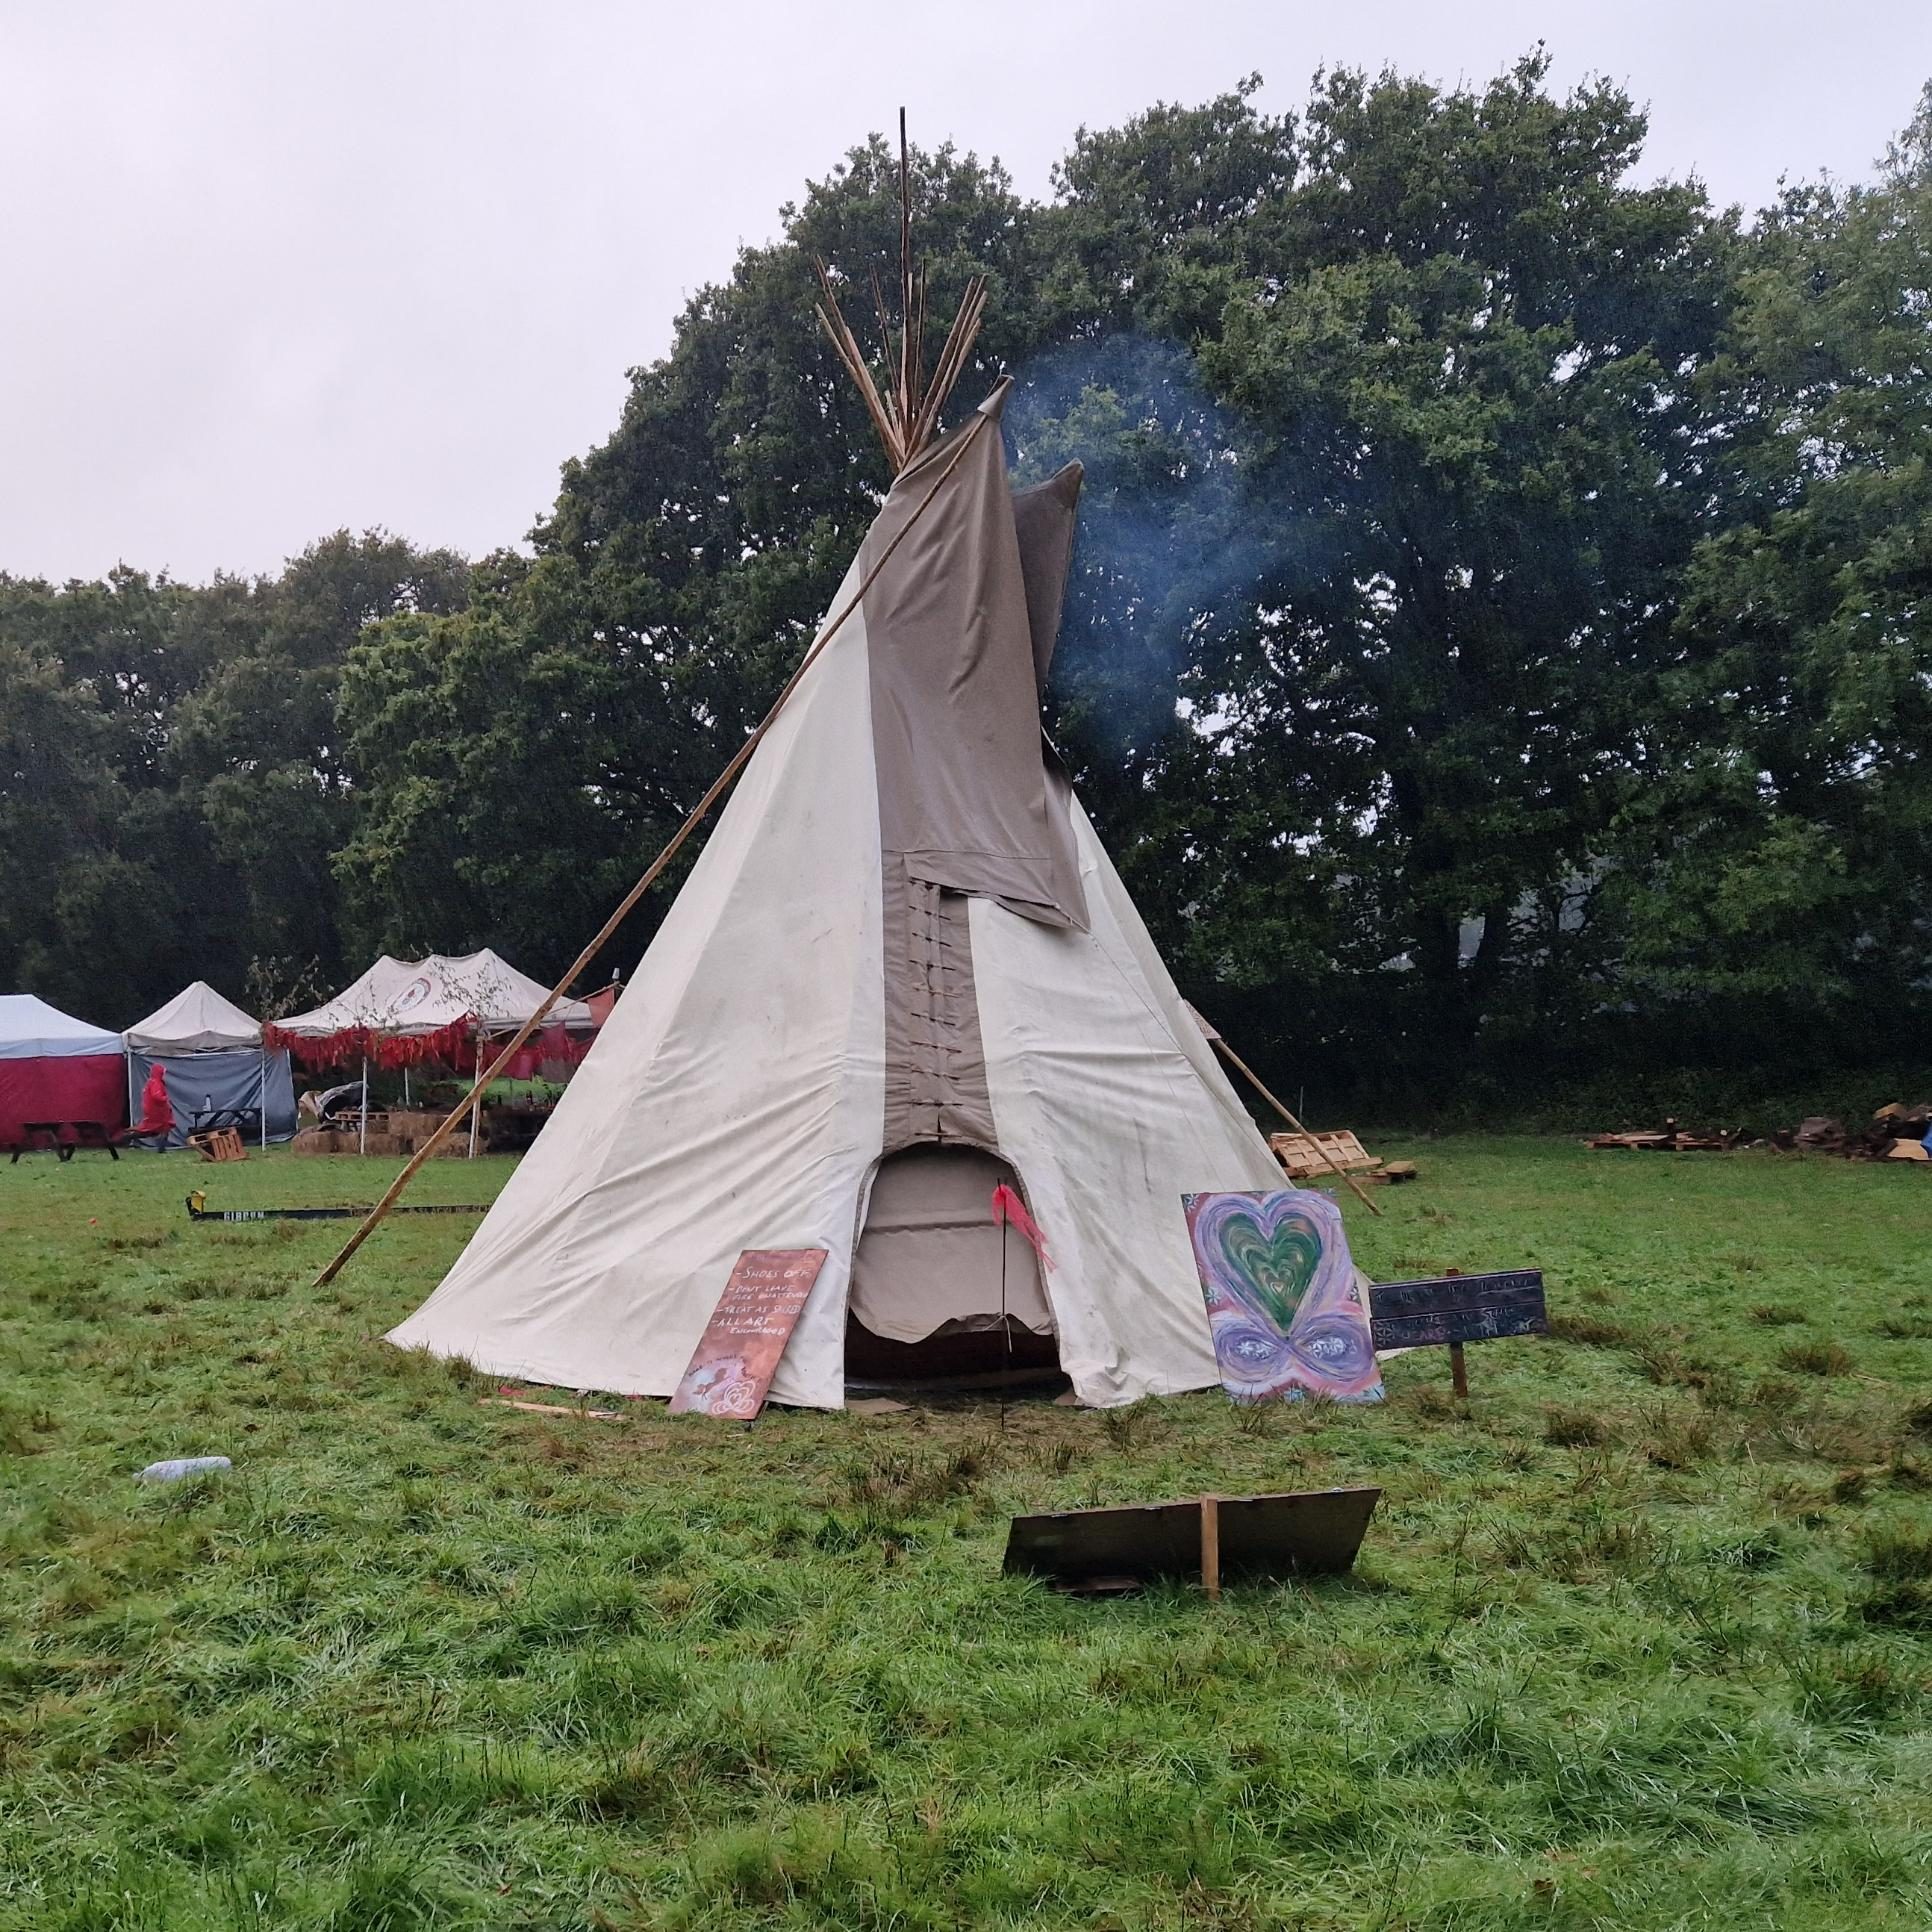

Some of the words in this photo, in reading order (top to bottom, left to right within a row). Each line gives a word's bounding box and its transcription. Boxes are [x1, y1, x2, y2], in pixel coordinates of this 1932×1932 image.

[742, 1266, 778, 1279] SHOES
[724, 1306, 752, 1315] TREAT
[717, 1317, 741, 1327] ALL
[743, 1316, 774, 1327] ART
